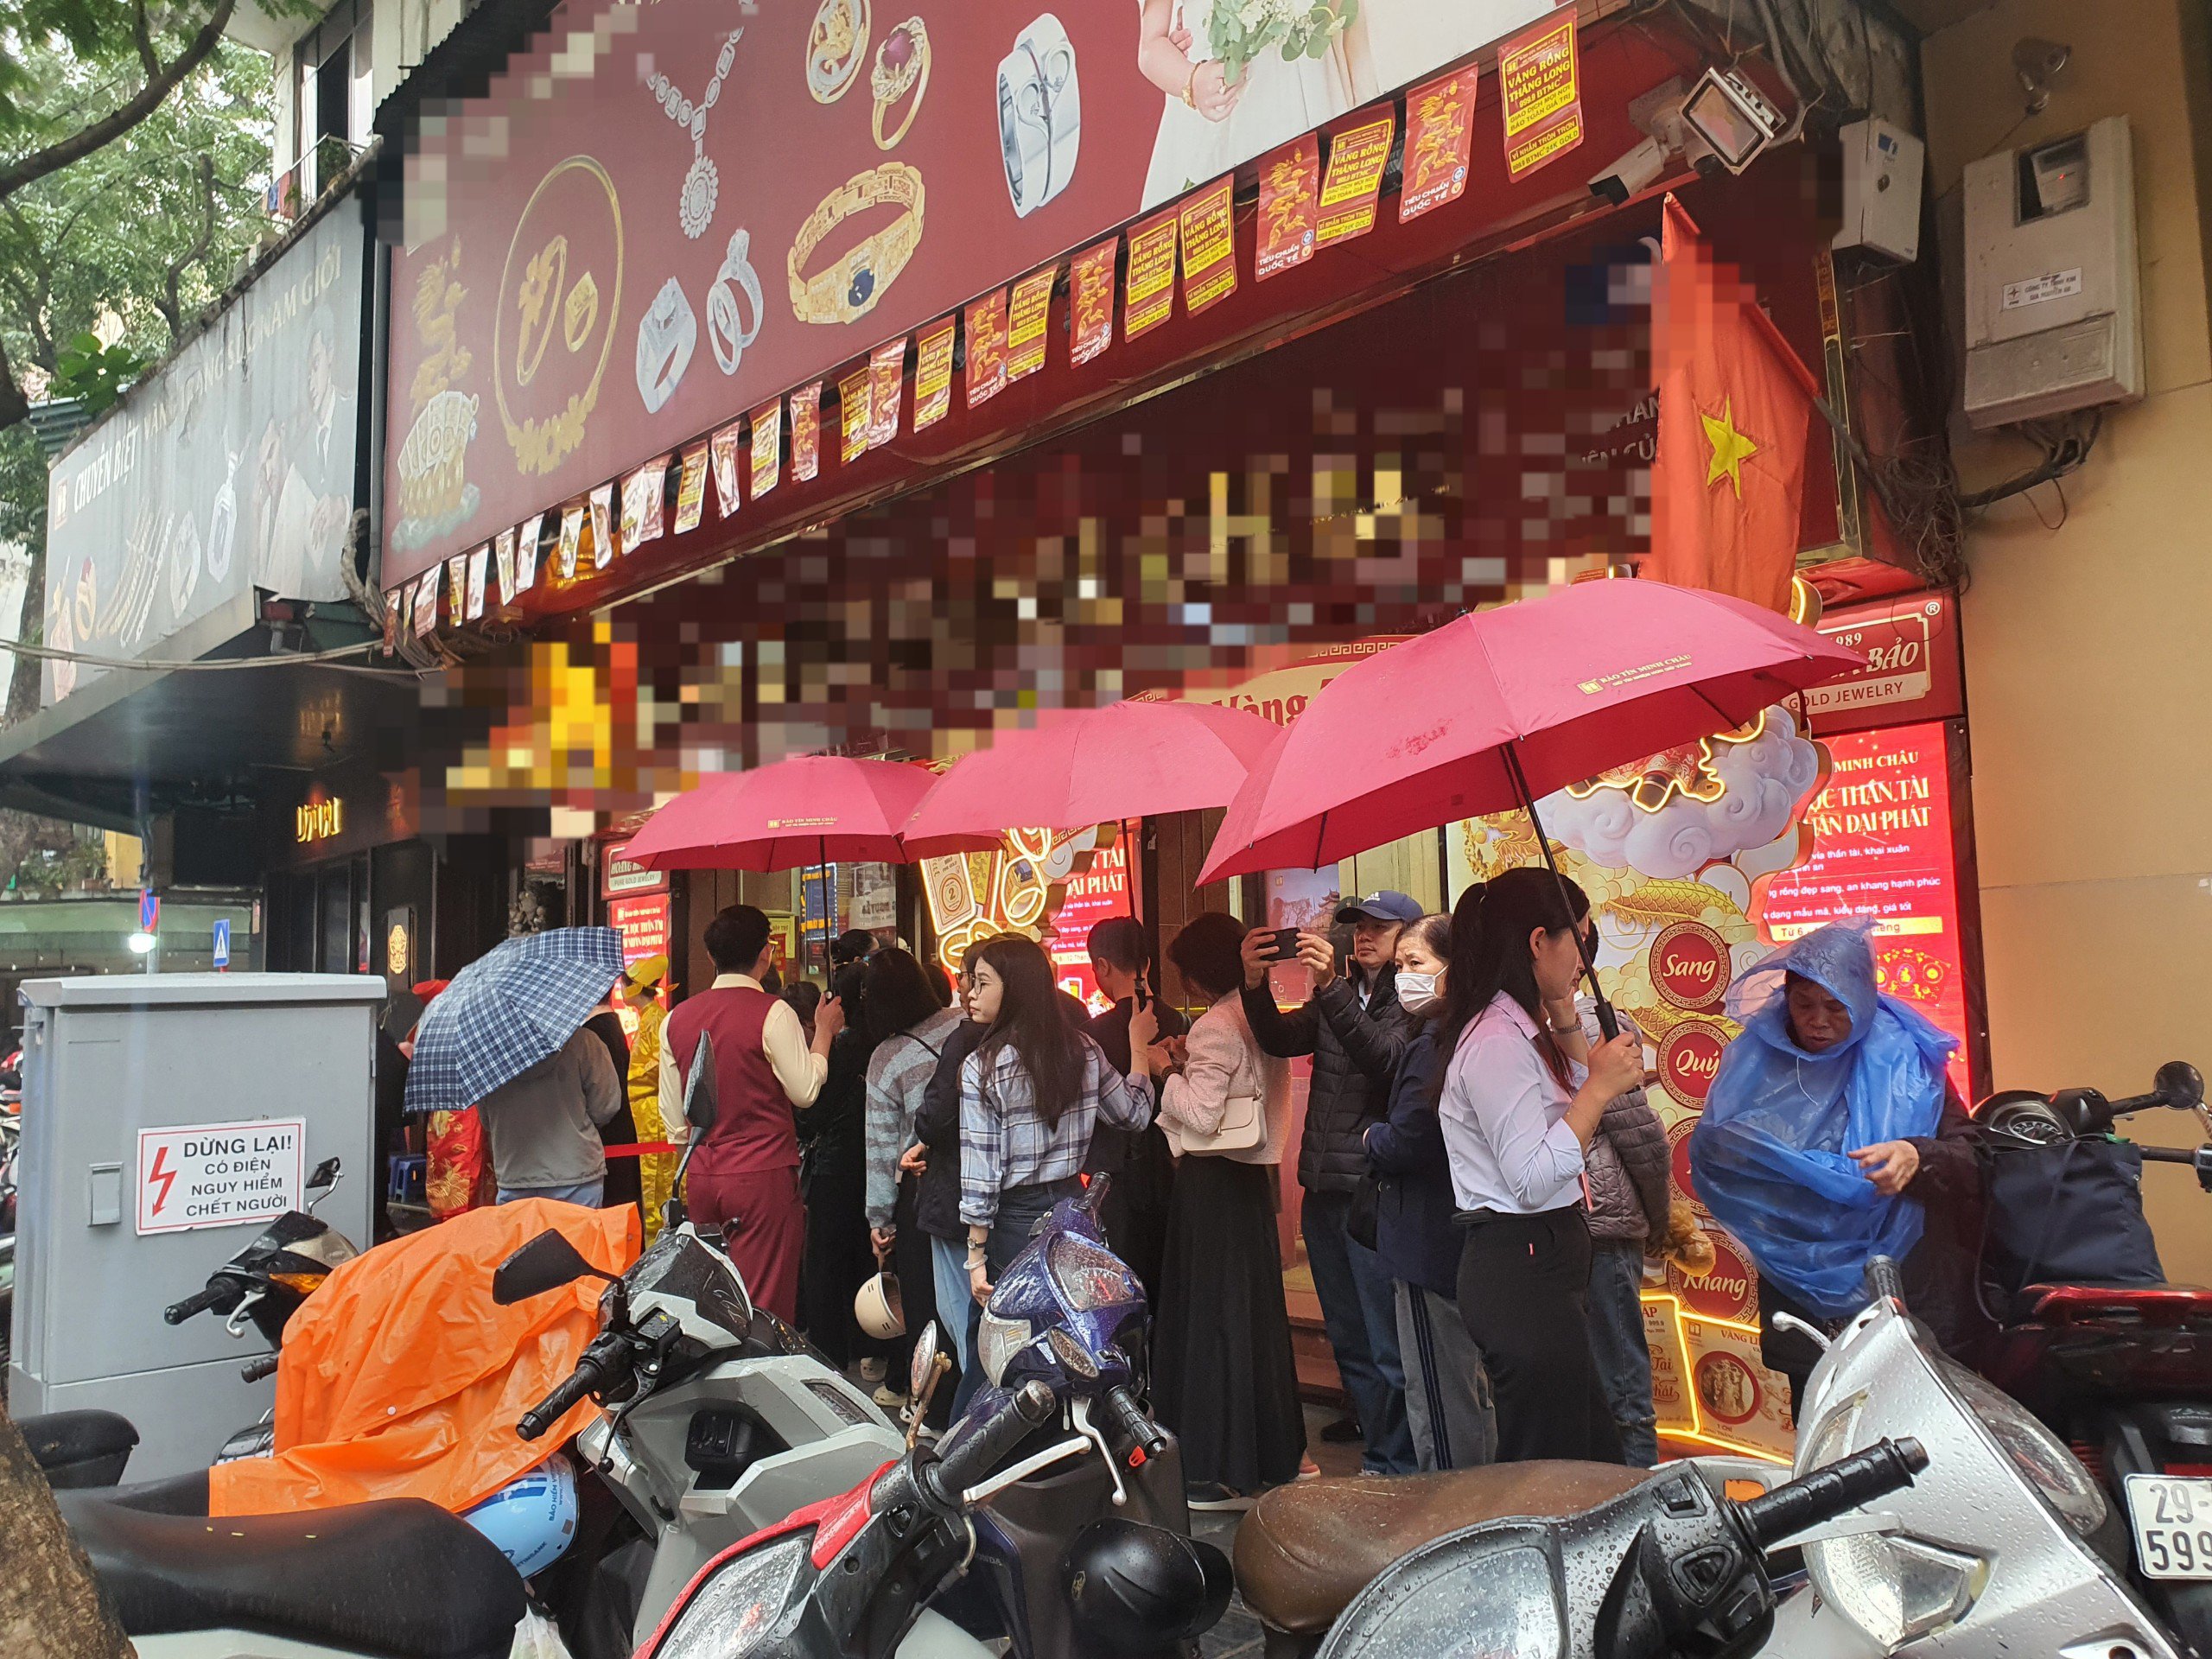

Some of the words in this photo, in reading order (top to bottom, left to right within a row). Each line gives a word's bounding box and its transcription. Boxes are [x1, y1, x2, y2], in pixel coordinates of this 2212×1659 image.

[1508, 64, 1537, 89] VÀNG
[1539, 48, 1569, 71] RỒNG
[1508, 75, 1542, 103] THĂNG
[1544, 60, 1571, 82] LONG
[1510, 110, 1527, 124] GIAO
[1527, 100, 1543, 115] DỊCH
[1544, 92, 1556, 105] MỌI
[1519, 93, 1535, 109] 999.9
[1538, 130, 1556, 149] TRÒN
[1545, 139, 1558, 156] 24K
[1559, 130, 1579, 148] GOLD
[1335, 149, 1359, 166] VÀNG
[1360, 142, 1386, 158] RỒNG
[1332, 162, 1359, 178] THĂNG
[1360, 155, 1383, 168] LONG
[1402, 198, 1432, 217] QUỐC
[1434, 189, 1449, 202] TẾ
[1404, 190, 1421, 207] TIÊU
[1421, 181, 1450, 200] CHUẨN
[1185, 220, 1205, 238] VÀNG
[1206, 207, 1228, 226] RỒNG
[1185, 230, 1209, 251] THĂNG
[1210, 219, 1228, 234] LONG
[1154, 251, 1173, 266] LONG
[1258, 251, 1275, 266] TIÊU
[1274, 243, 1300, 260] CHUẨN
[1258, 258, 1284, 276] QUỐC
[1287, 251, 1299, 264] TẾ
[260, 283, 297, 340] NAM
[302, 243, 342, 305] GIỚI
[74, 442, 112, 513] CHUYÊN
[113, 424, 140, 485] BIỆT
[1832, 632, 1862, 647] 989
[1866, 636, 1920, 673] BẢO
[1599, 672, 1621, 684] BẢO
[1618, 668, 1637, 678] TÍN
[1637, 661, 1665, 673] MINH
[1663, 653, 1693, 666] CHÂU
[1834, 681, 1904, 703] JEWELRY
[1833, 757, 1873, 773] MINH
[1876, 749, 1919, 767] CHÂU
[1838, 778, 1893, 807] THẦN
[1896, 774, 1929, 801] TÀI
[1880, 804, 1932, 830] PHÁT
[1099, 846, 1125, 869] TÀI
[1827, 848, 1847, 859] thần
[1865, 846, 1885, 856] khai
[1886, 844, 1910, 855] xuân
[949, 887, 956, 900] 2
[1087, 870, 1125, 894] PHÁT
[1800, 885, 1818, 896] đẹp
[1847, 883, 1859, 892] an
[1860, 880, 1889, 892] khang
[1891, 877, 1915, 890] hạnh
[1916, 876, 1942, 889] phúc
[1770, 909, 1791, 920] dạng
[1883, 903, 1897, 914] giá
[1899, 900, 1912, 912] tốt
[1781, 927, 1795, 938] Từ
[1797, 927, 1804, 937] 6
[1662, 953, 1717, 983] Sang
[1675, 1049, 1721, 1080] Quý
[183, 1136, 246, 1158] DỪNG
[253, 1135, 292, 1154] LẠI!
[205, 1160, 229, 1175] CÓ
[233, 1157, 271, 1174] ĐIỆN
[191, 1181, 238, 1197] NGUY
[244, 1172, 283, 1192] HIỂM
[186, 1197, 232, 1217] CHẾT
[236, 1193, 288, 1212] NGƯỜI
[1683, 1274, 1747, 1301] Khang
[1720, 1329, 1747, 1344] VÀNG
[1749, 1334, 1759, 1345] LI
[1654, 1383, 1674, 1397] hát
[548, 1503, 557, 1522] BẢO
[2150, 1483, 2212, 1524] 29-
